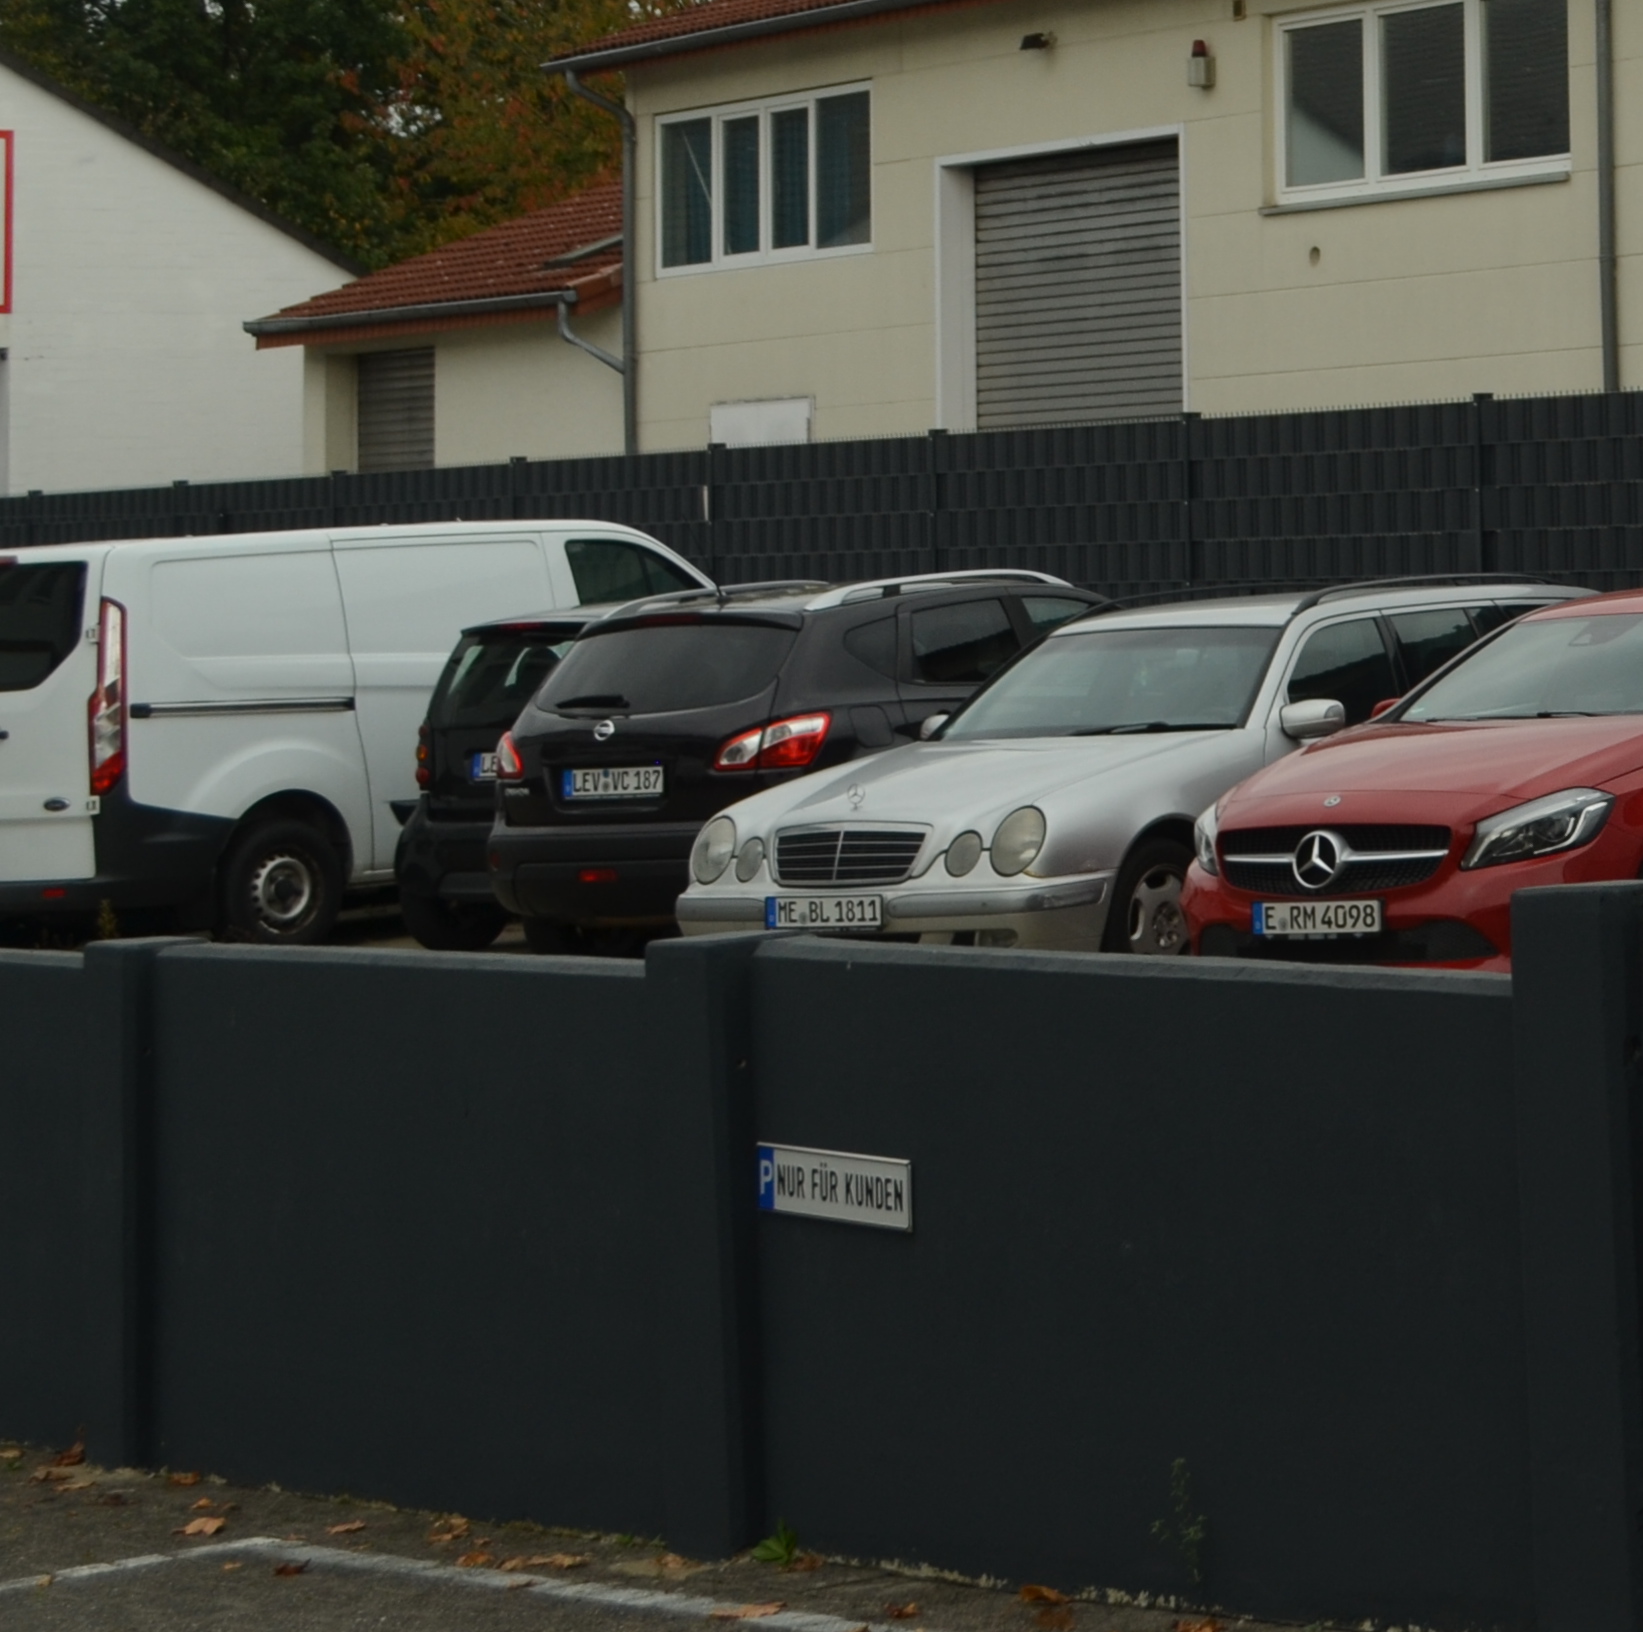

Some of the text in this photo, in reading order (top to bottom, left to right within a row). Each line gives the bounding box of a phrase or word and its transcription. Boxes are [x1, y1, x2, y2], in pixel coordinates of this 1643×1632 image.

[573, 770, 661, 792] LEV VC 187
[778, 899, 878, 923] ME BL 1811
[1264, 904, 1375, 930] E RM 4098
[759, 1159, 904, 1212] P NUR FÜR KUNDEN
